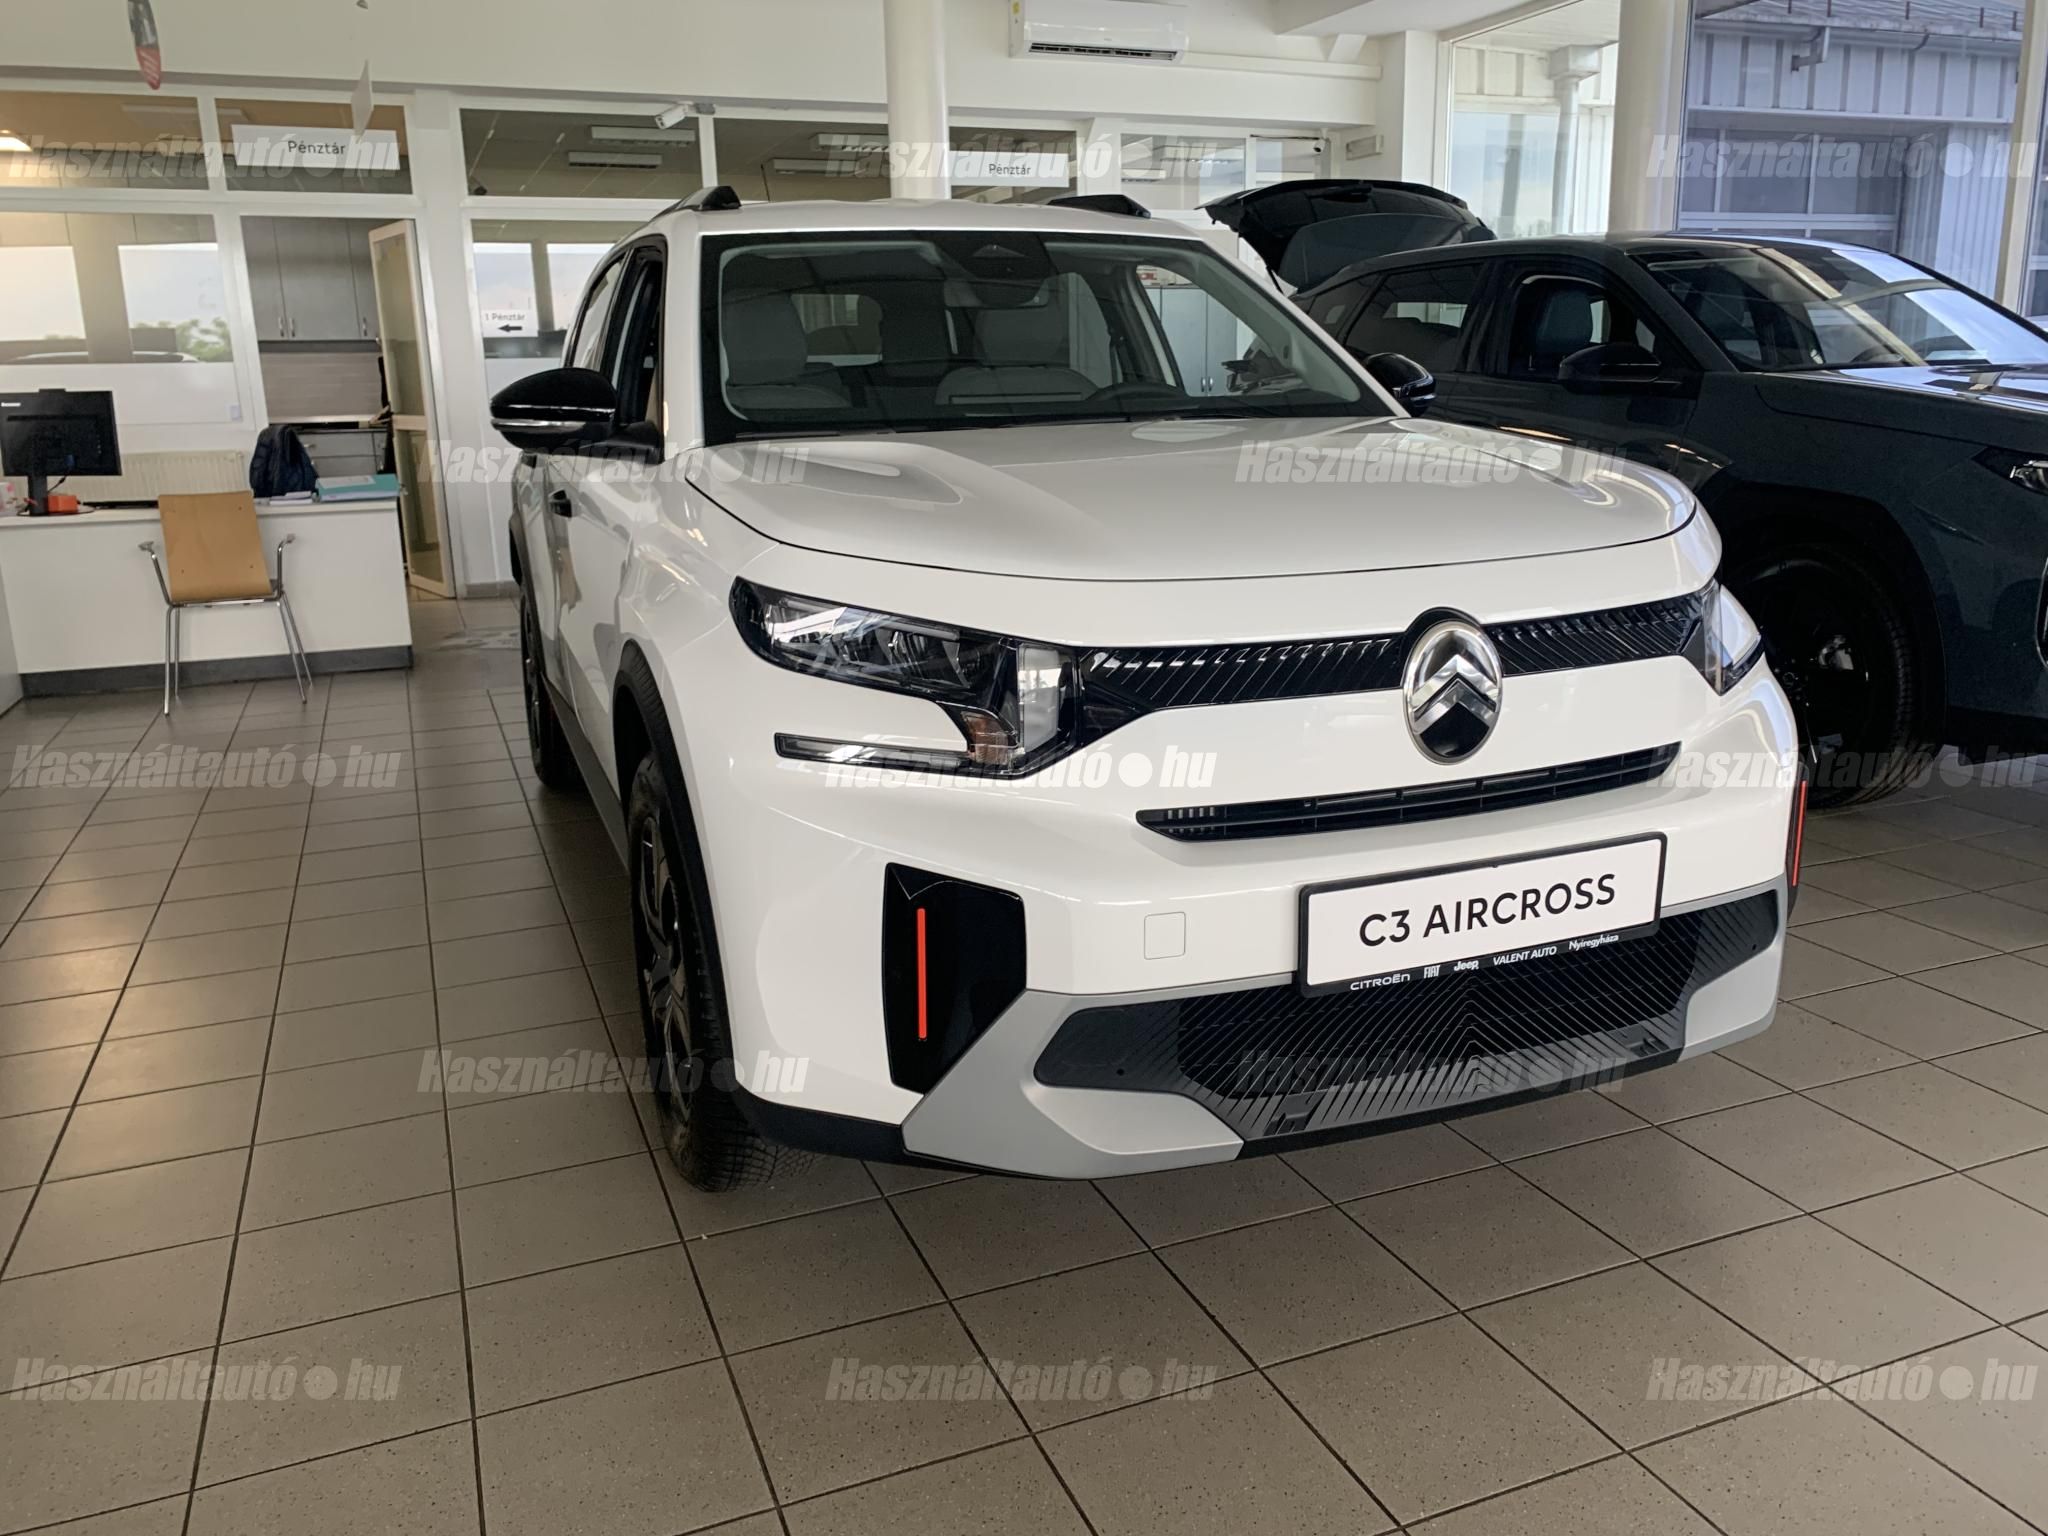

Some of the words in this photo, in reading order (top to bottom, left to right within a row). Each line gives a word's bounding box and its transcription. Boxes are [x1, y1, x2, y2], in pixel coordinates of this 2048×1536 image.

[287, 140, 346, 155] Pénztár
[988, 163, 1032, 175] Pénztár
[1358, 908, 1411, 947] C3
[1422, 873, 1616, 939] AIRCROSS
[1423, 965, 1441, 979] FIAT
[1453, 960, 1479, 972] Jeep
[1492, 951, 1529, 966] VALENT
[1530, 946, 1557, 960] AUTO
[1568, 934, 1619, 951] Nyíregyháza
